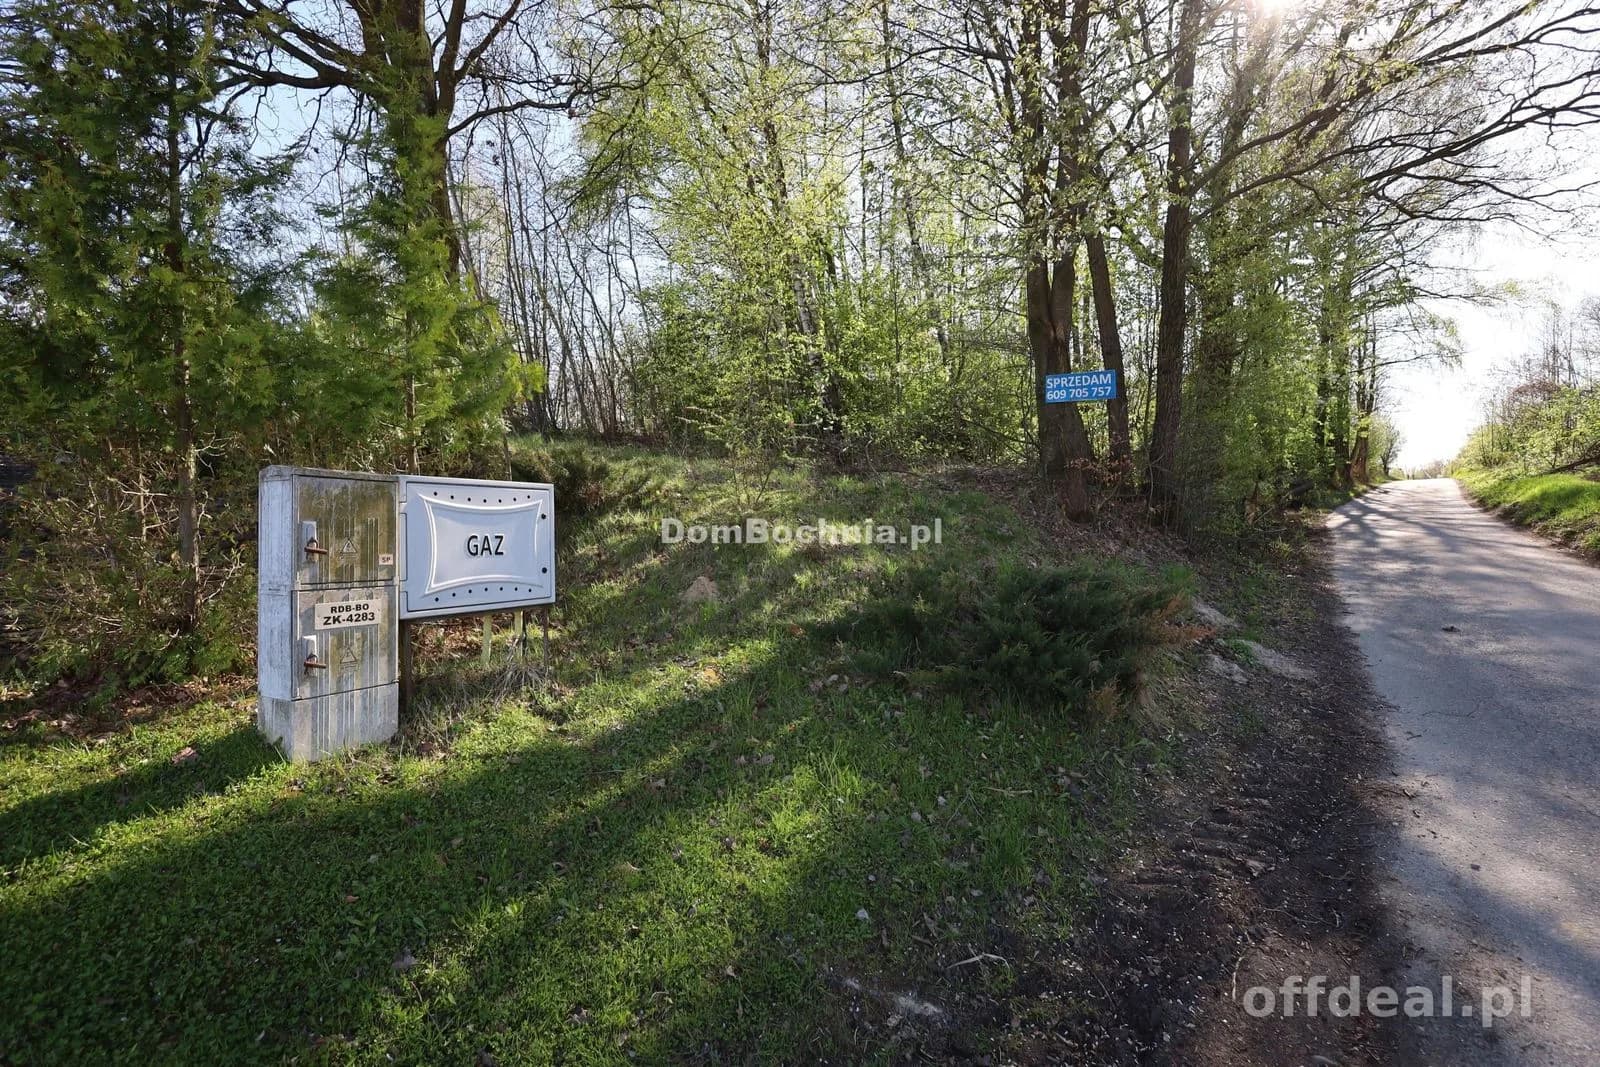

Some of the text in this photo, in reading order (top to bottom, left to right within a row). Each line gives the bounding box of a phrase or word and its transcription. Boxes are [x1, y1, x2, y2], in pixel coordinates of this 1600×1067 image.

[1046, 373, 1112, 389] SPRZEDAM
[1047, 386, 1112, 400] 609 705 757
[467, 534, 505, 556] GAZ
[330, 603, 370, 614] RDB-BO
[323, 612, 375, 626] ZK-4283
